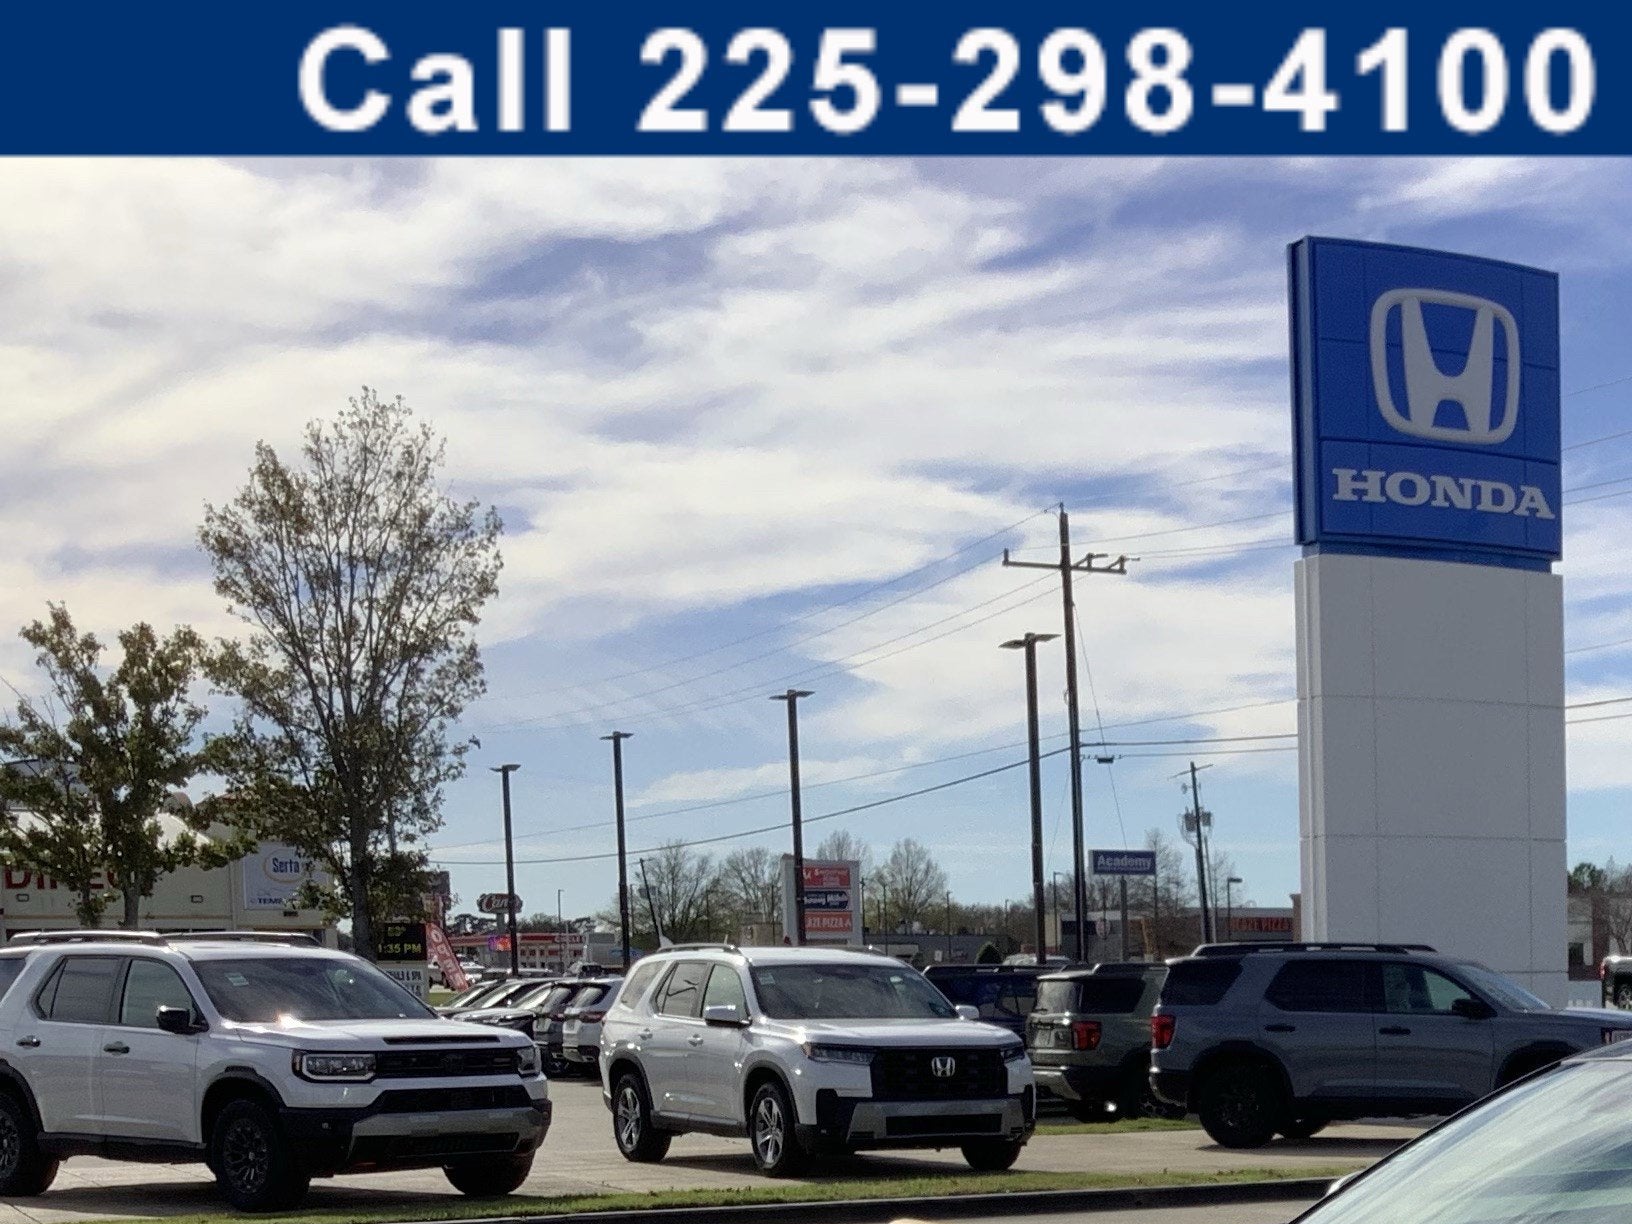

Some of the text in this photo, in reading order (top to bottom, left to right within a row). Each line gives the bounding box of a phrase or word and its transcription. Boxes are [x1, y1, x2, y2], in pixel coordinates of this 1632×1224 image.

[1332, 467, 1556, 519] HONDA
[272, 857, 300, 874] Serta
[1097, 854, 1152, 870] Academy
